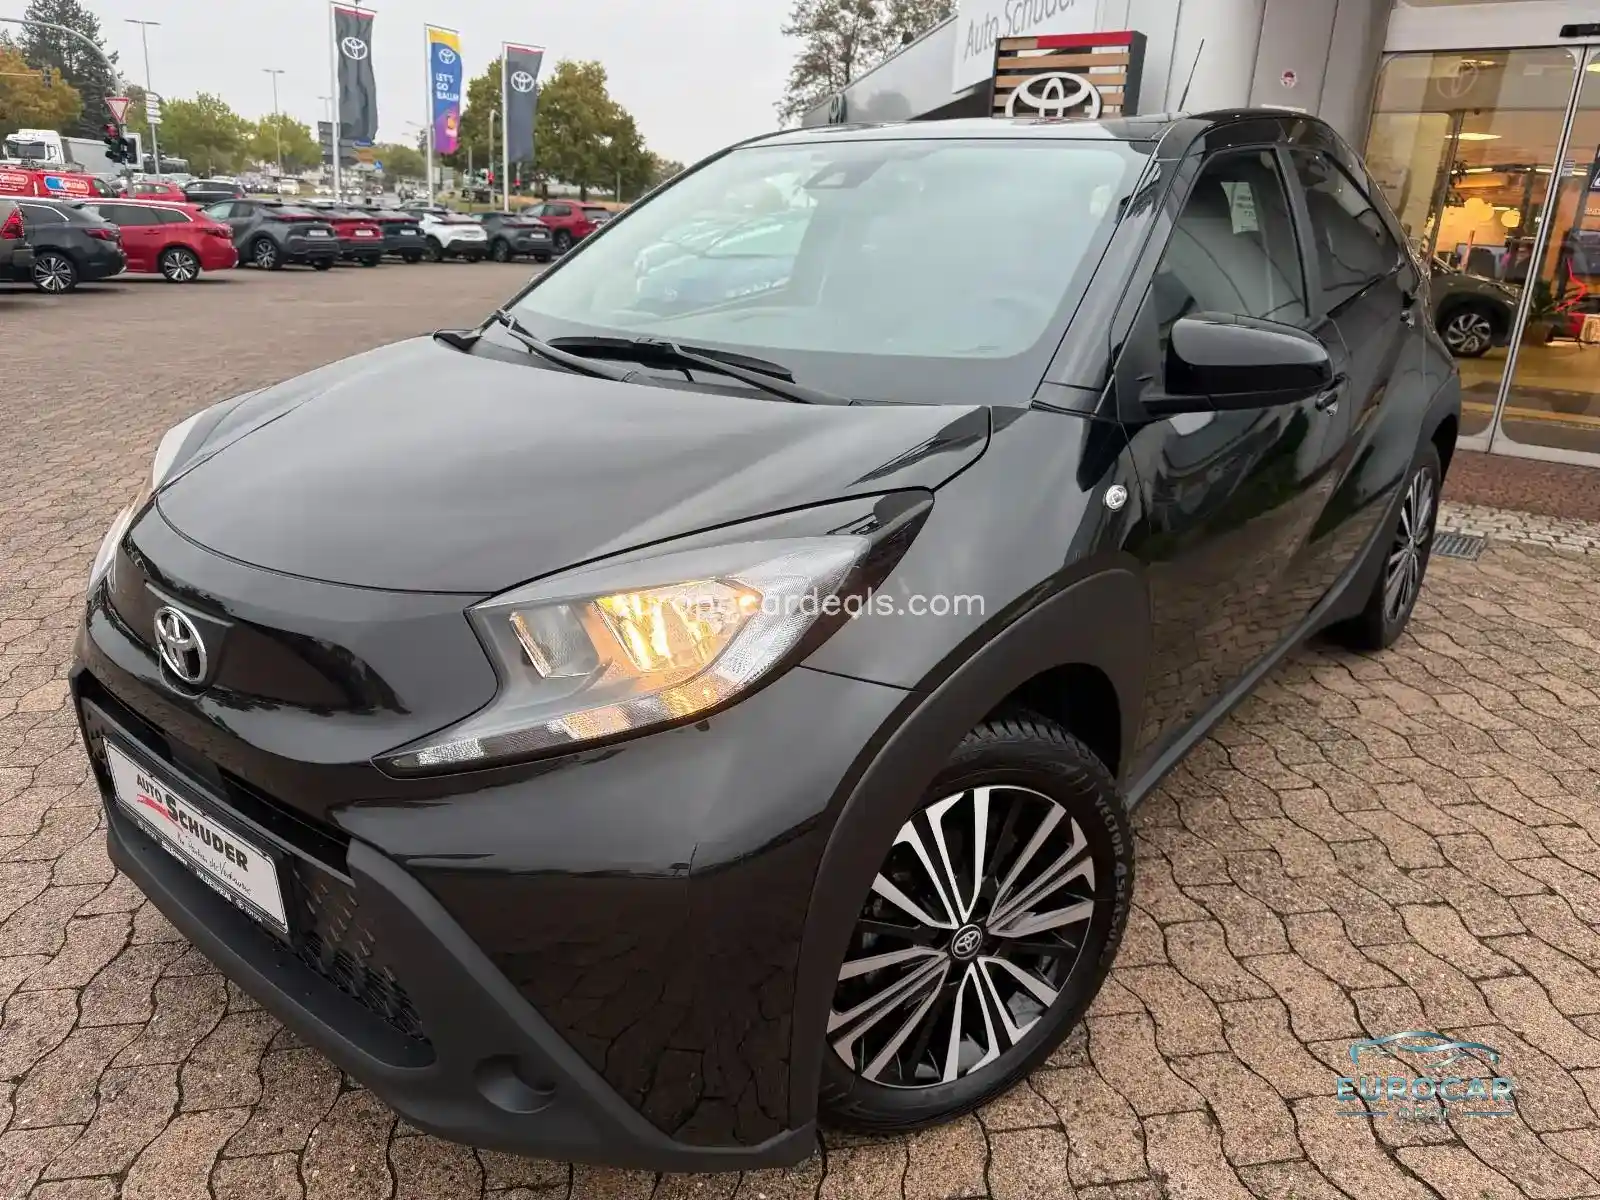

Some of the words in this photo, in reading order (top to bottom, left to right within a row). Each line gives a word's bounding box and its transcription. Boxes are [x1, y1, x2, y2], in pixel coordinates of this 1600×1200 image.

[964, 12, 999, 63] Auto
[436, 82, 449, 91] GO
[136, 774, 163, 804] AUTO
[1095, 795, 1125, 856] VECTOR
